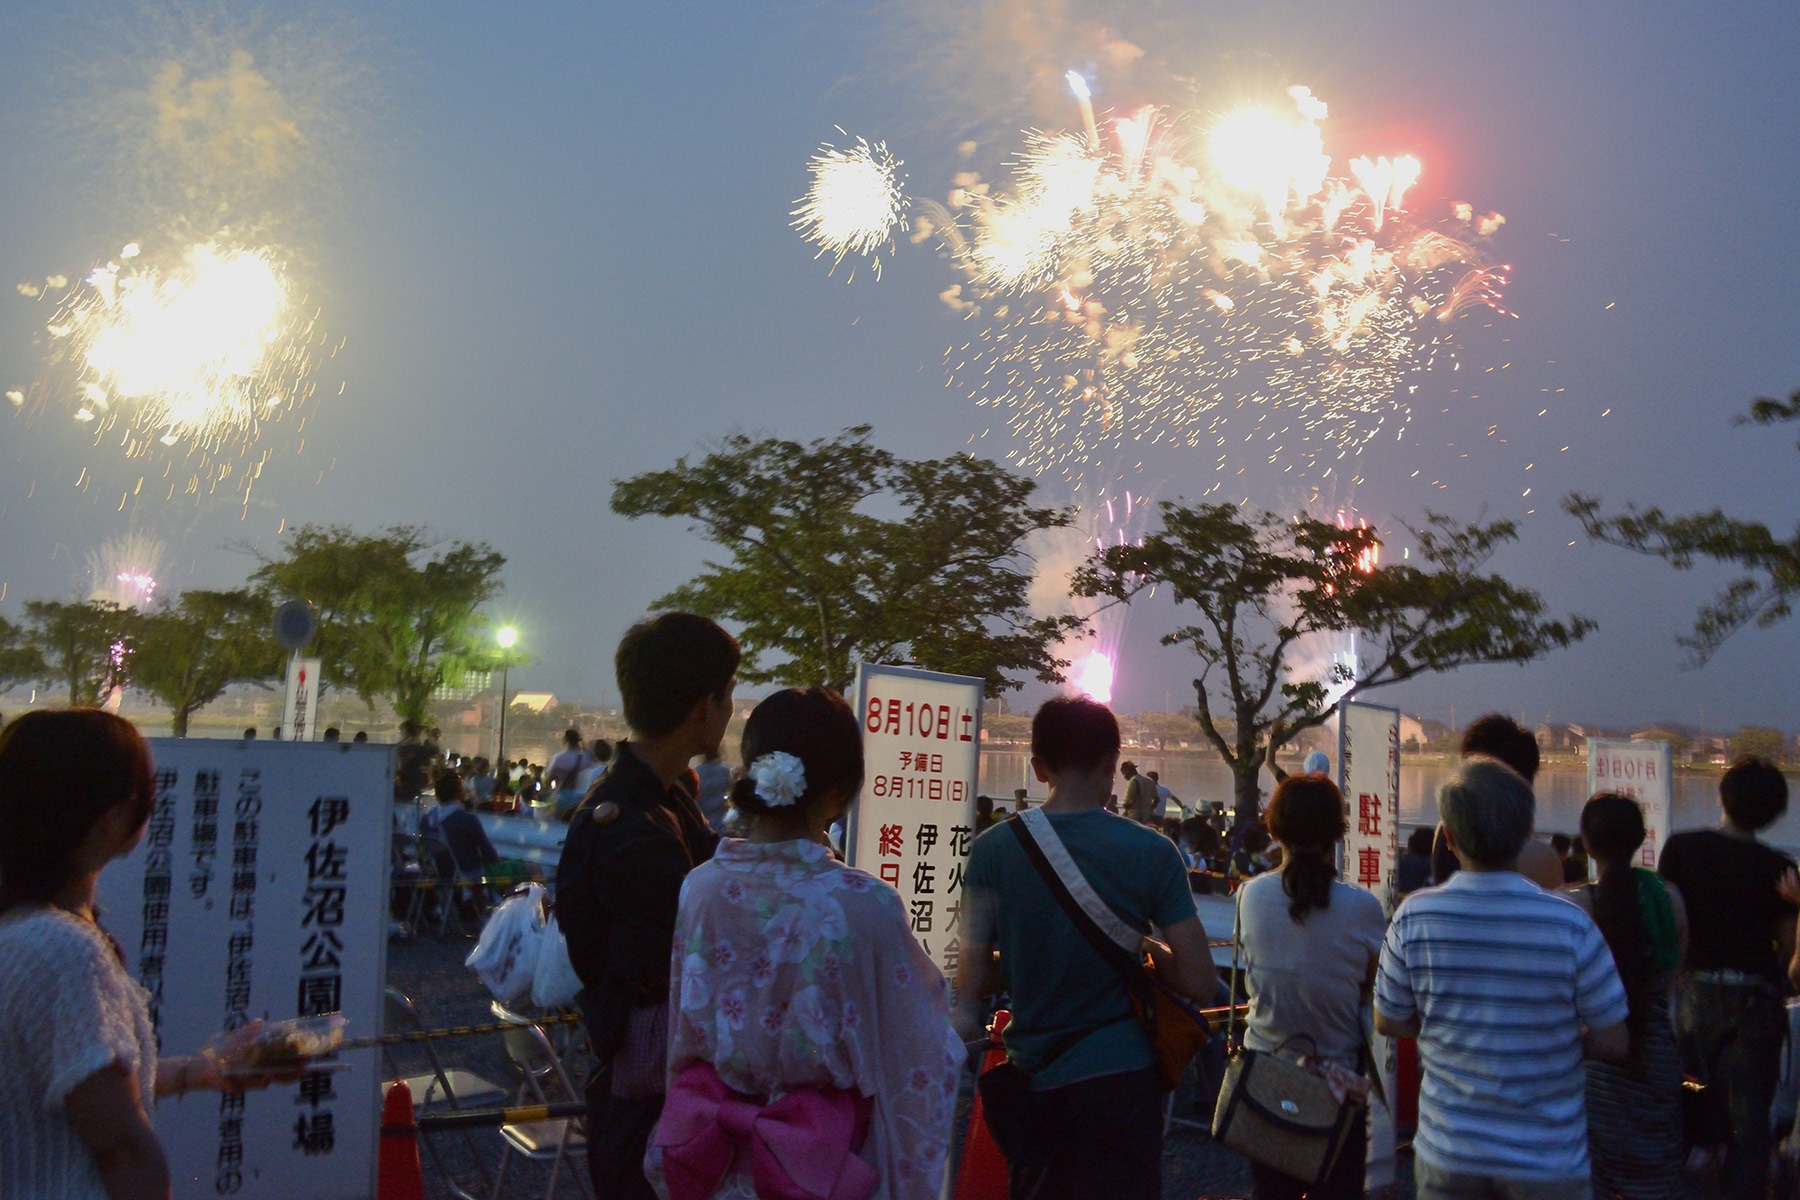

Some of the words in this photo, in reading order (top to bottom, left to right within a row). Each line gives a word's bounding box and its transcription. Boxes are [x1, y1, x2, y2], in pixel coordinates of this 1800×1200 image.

[866, 696, 980, 743] 8月10日(土)
[899, 751, 943, 773] 予備日
[873, 775, 969, 802] 8月11日(日)
[1358, 792, 1382, 889] 駐車
[910, 823, 938, 956] 伊佐沼
[943, 825, 973, 1008] 花火大会
[215, 768, 262, 1196] この駐車場は、伊佐沼公用者用の
[292, 795, 350, 1157] 伊佐沼公園車場
